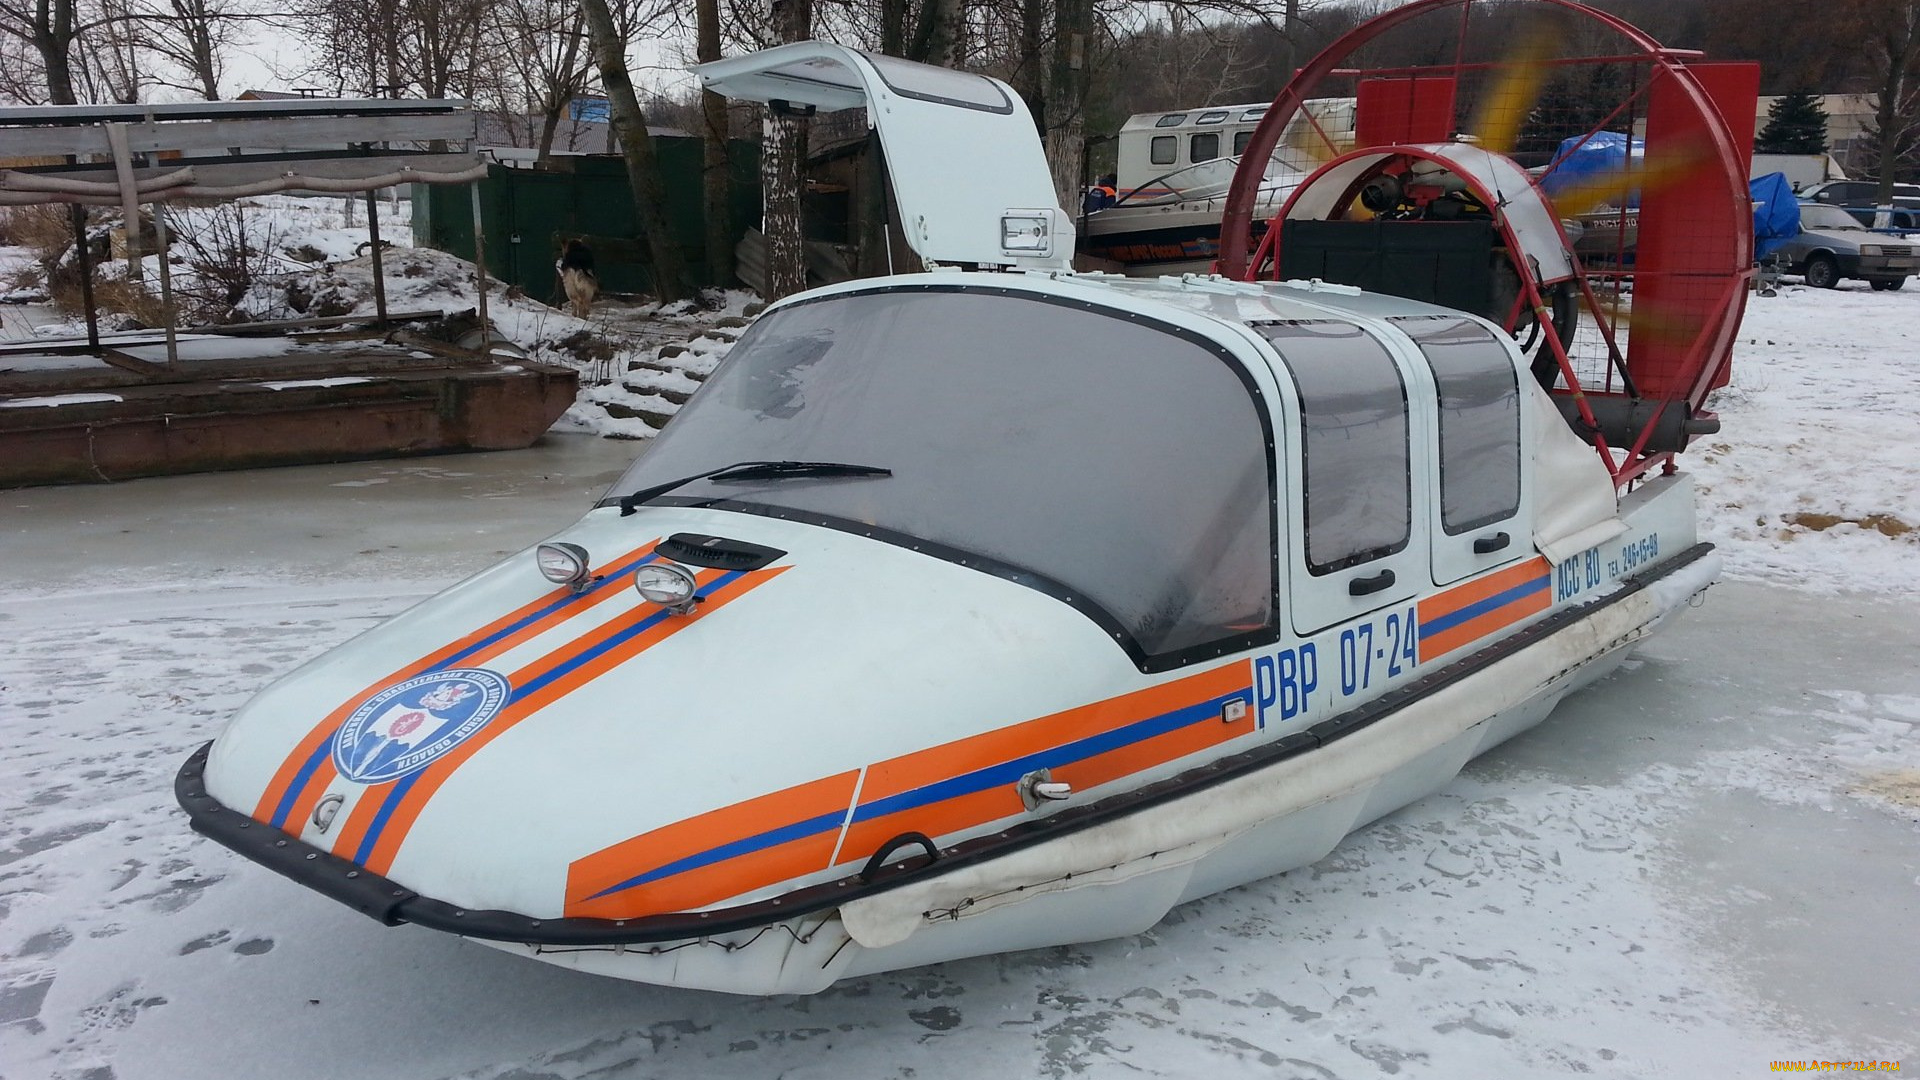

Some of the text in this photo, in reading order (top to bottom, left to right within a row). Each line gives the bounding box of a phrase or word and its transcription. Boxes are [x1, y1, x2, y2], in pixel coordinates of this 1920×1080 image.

[1558, 554, 1580, 603] АСС
[1340, 607, 1416, 697] 07-24
[397, 739, 452, 770] ОБЛАСТИ
